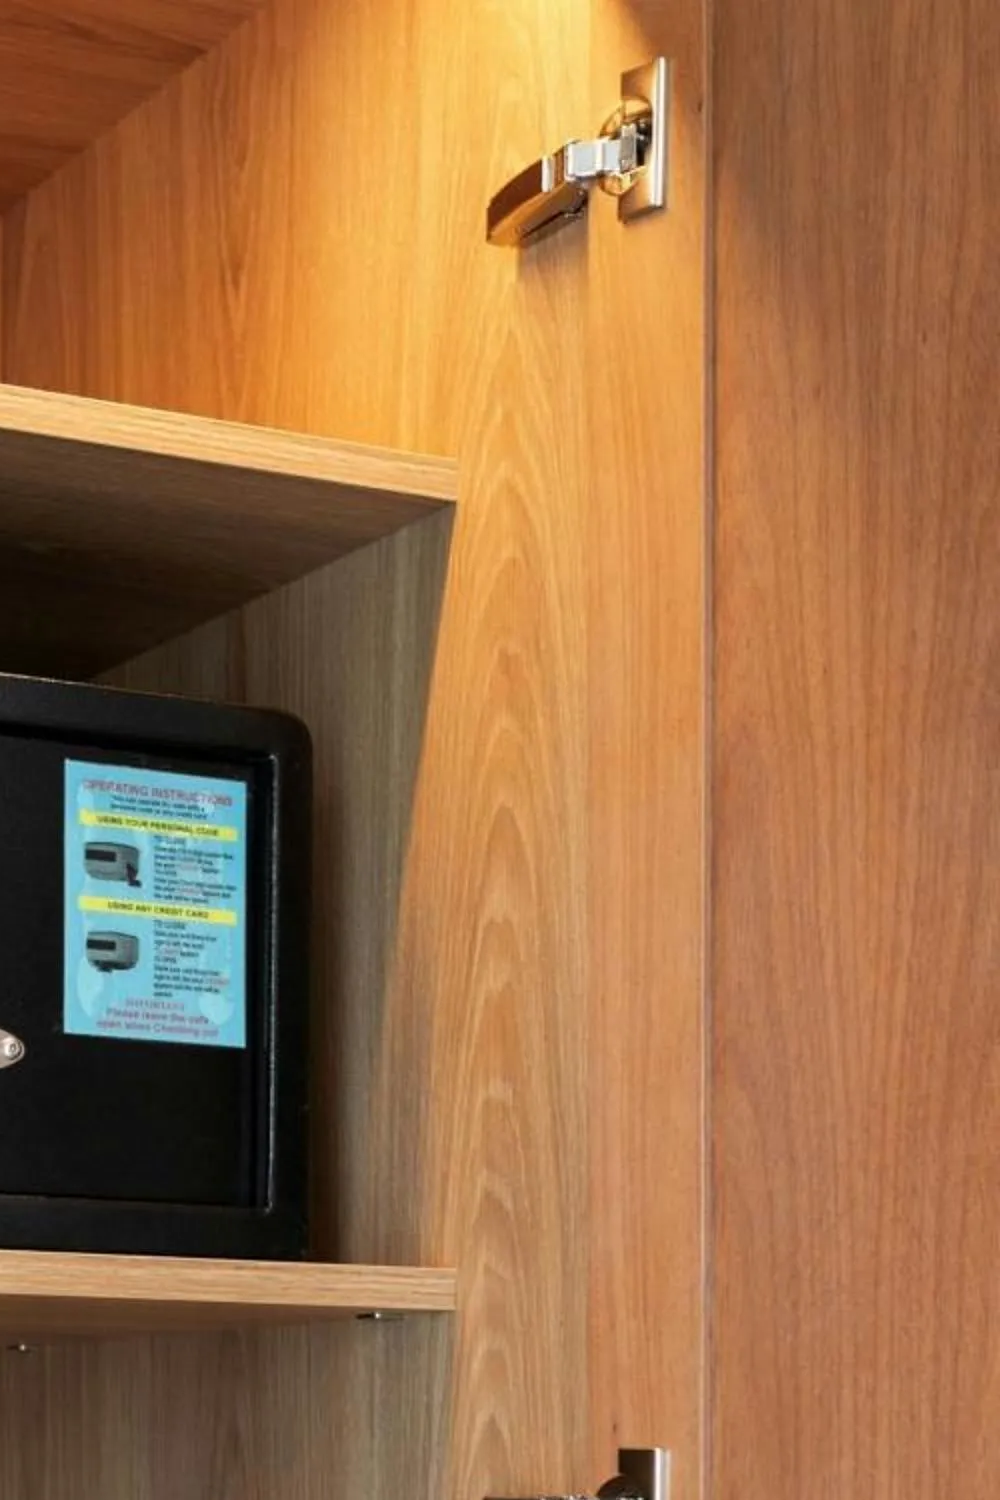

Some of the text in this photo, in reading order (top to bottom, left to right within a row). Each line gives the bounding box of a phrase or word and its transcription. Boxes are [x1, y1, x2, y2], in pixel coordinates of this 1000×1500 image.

[83, 779, 148, 797] OPERATING
[152, 787, 232, 806] INSTRUCTIONS
[96, 815, 122, 825] USING
[126, 818, 148, 828] YOUR
[150, 820, 192, 834] PERSONAL
[107, 901, 209, 919] USING ANY CREDIT CARD
